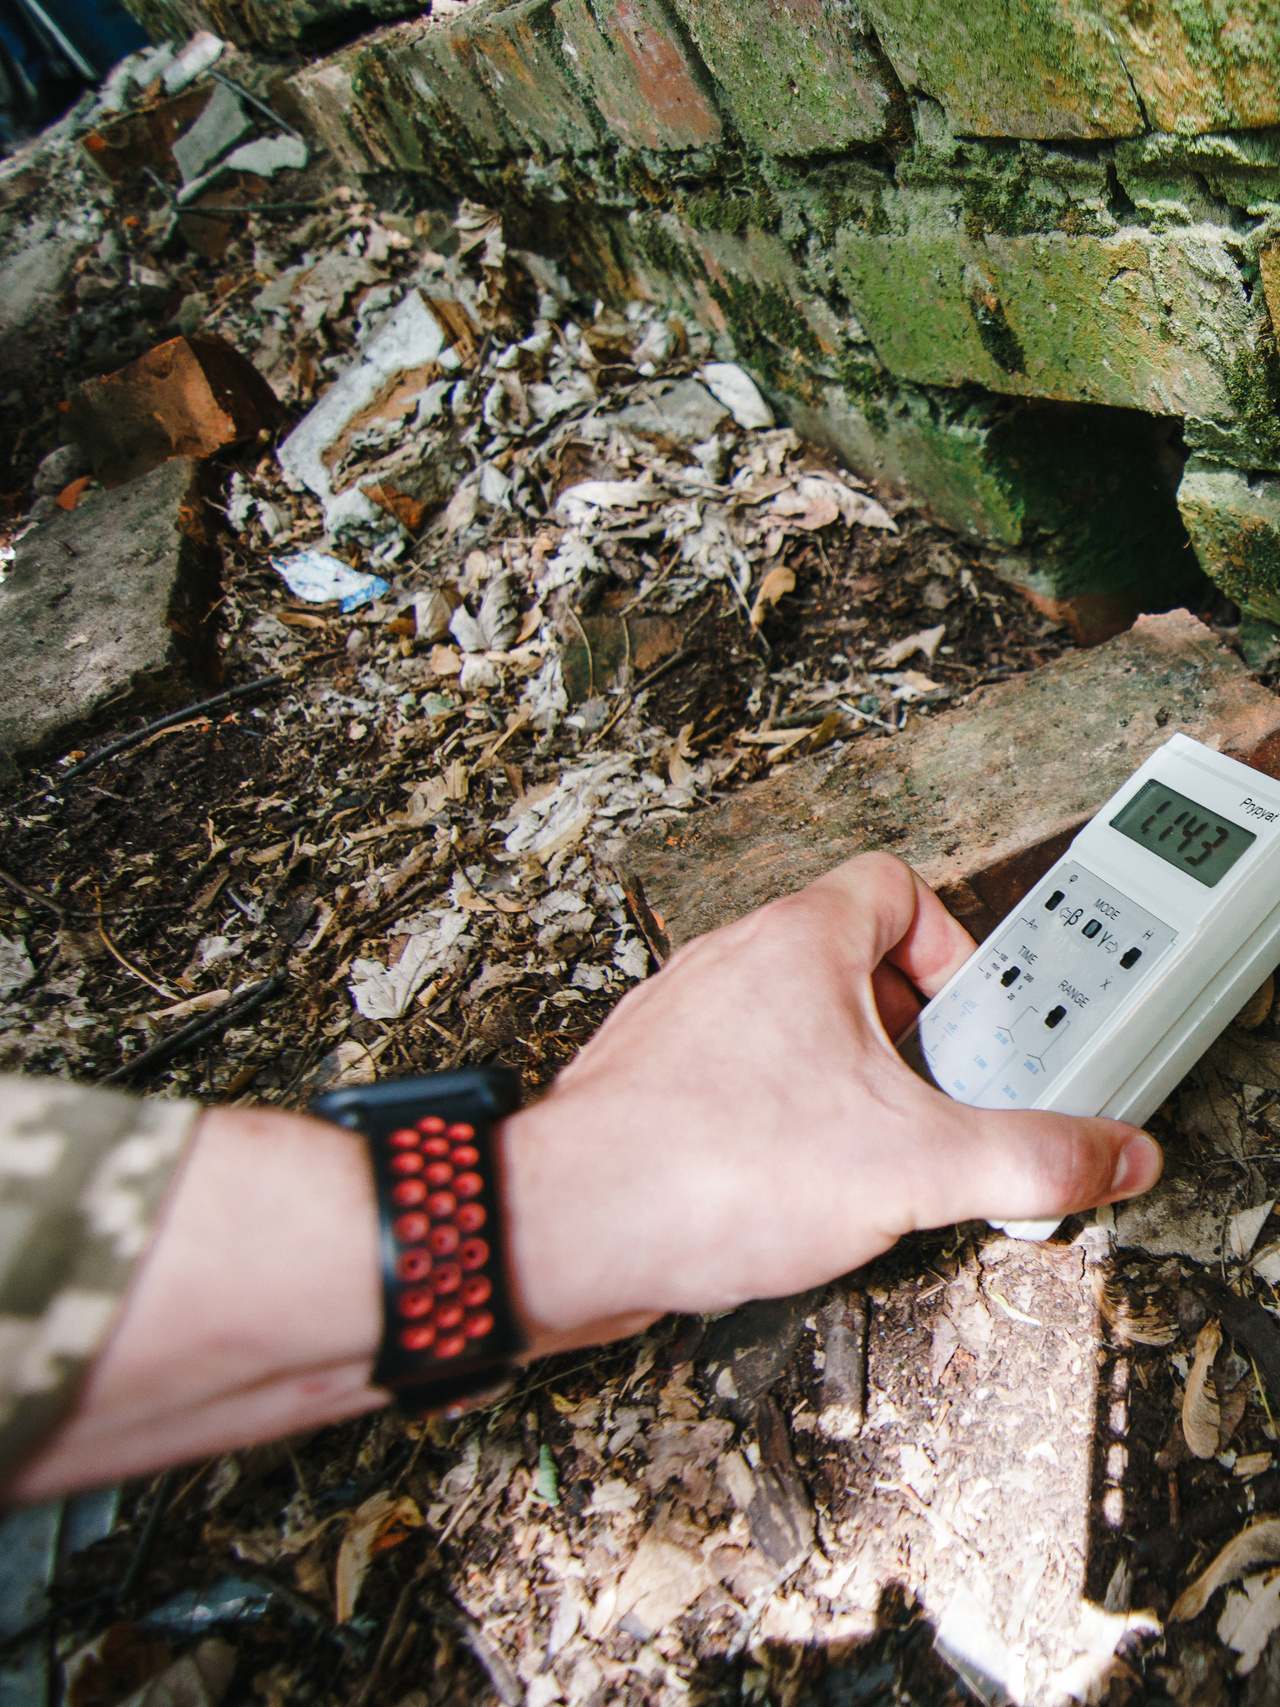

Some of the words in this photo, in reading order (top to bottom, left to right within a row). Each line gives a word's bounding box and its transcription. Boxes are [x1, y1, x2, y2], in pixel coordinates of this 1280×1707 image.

[1239, 797, 1280, 823] Prypyat
[1063, 908, 1084, 926] β
[1093, 898, 1121, 921] MODE
[1017, 945, 1038, 965] TIME
[1058, 979, 1090, 1008] RANGE
